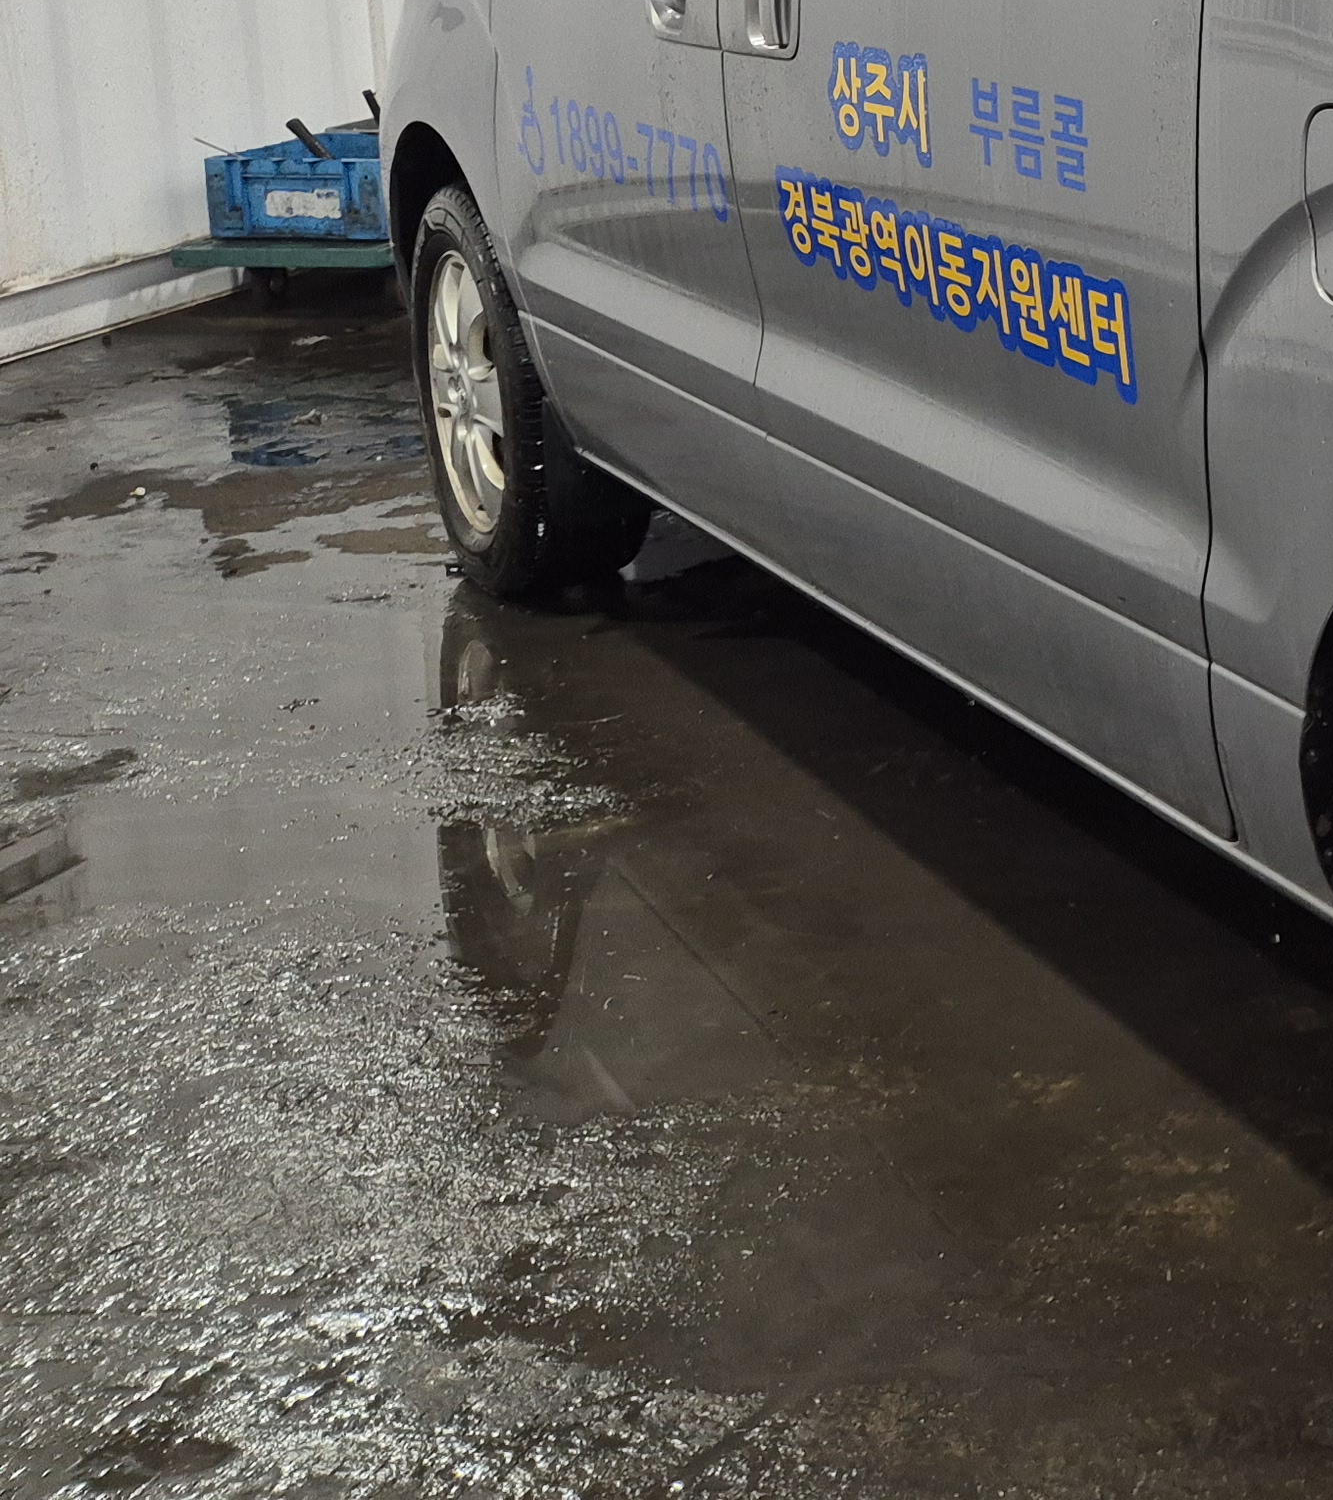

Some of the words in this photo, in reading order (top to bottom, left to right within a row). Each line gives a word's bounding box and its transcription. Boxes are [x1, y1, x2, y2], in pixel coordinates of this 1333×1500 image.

[550, 96, 729, 223] 1899-7770
[832, 56, 929, 154] 상주시
[969, 78, 1089, 192] 부름콜
[779, 180, 1131, 386] 경북광역이동지원센터
